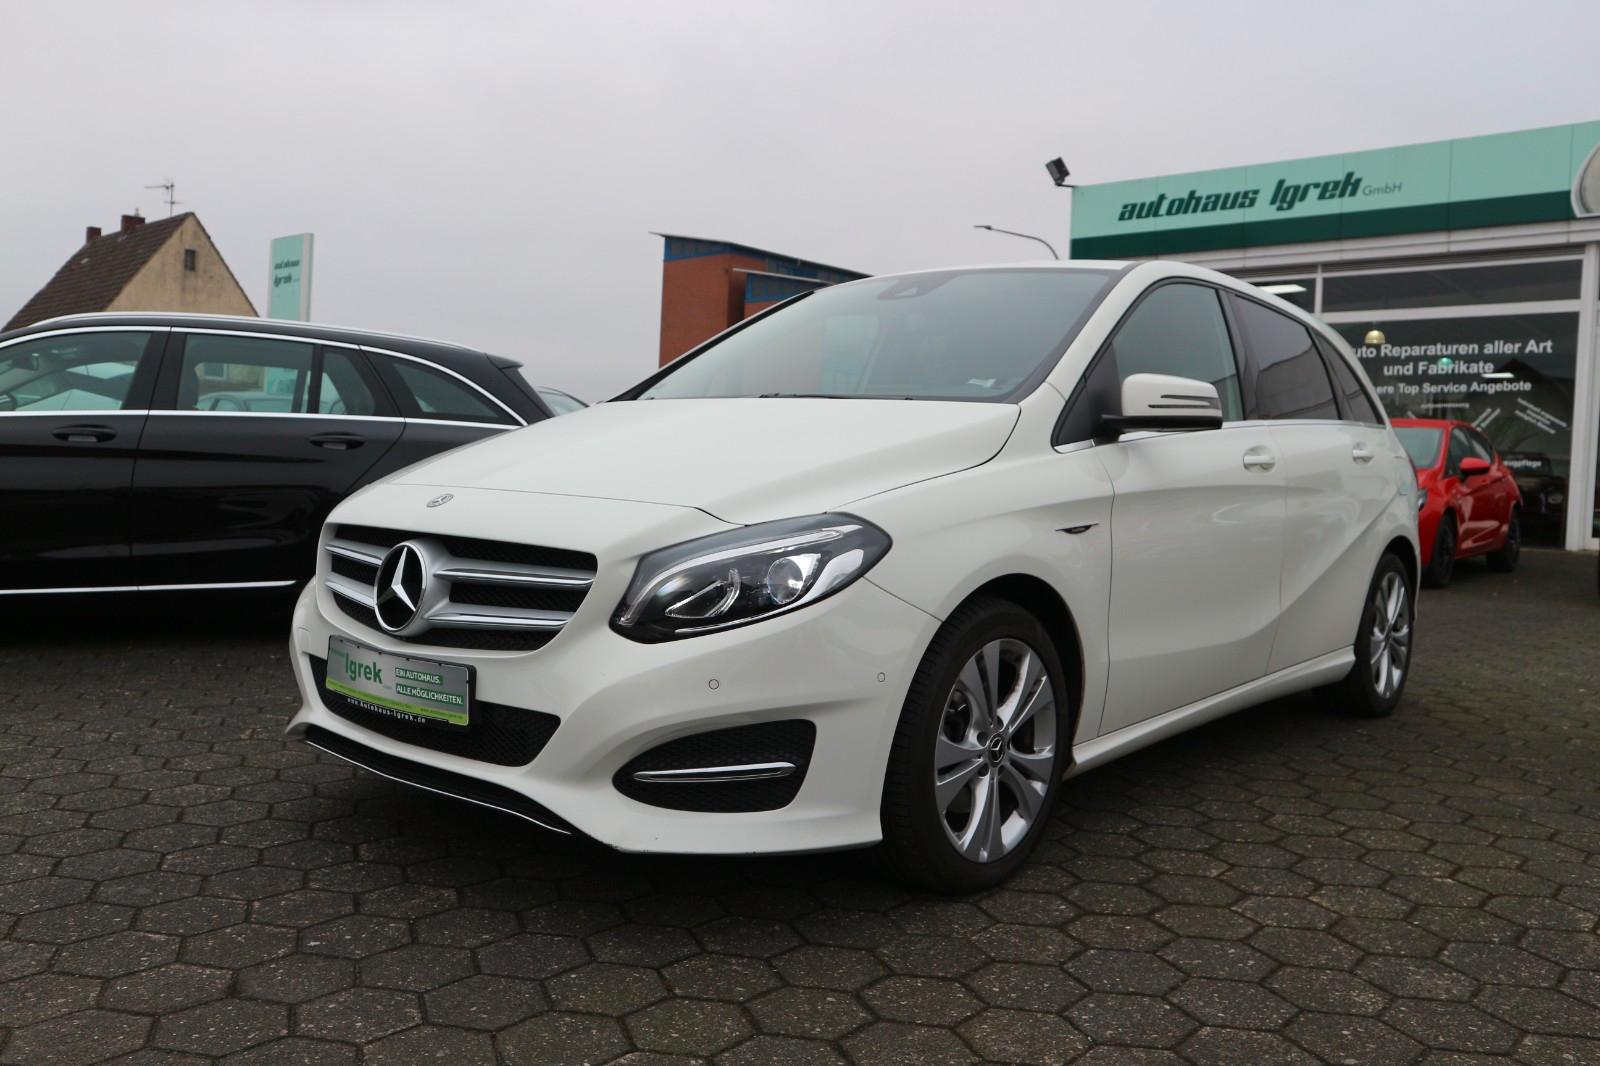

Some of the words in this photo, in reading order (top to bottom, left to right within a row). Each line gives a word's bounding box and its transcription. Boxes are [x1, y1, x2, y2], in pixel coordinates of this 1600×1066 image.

[1118, 189, 1261, 221] autohaus
[1269, 171, 1363, 211] Igrek
[1363, 182, 1402, 197] GmbH
[1380, 343, 1480, 359] Reparaturen
[1483, 340, 1521, 354] aller
[1524, 339, 1553, 354] Art
[1383, 362, 1413, 376] und
[1418, 360, 1494, 375] Fabrikate
[1398, 383, 1419, 395] Top
[1422, 382, 1467, 393] Service
[1470, 381, 1532, 394] Angebote
[345, 652, 383, 684] Igrek
[396, 669, 406, 677] EIN
[405, 671, 441, 684] AUTOHAUS.
[397, 684, 412, 696] ALLE
[411, 687, 464, 705] MÖGLICHKEITEN.
